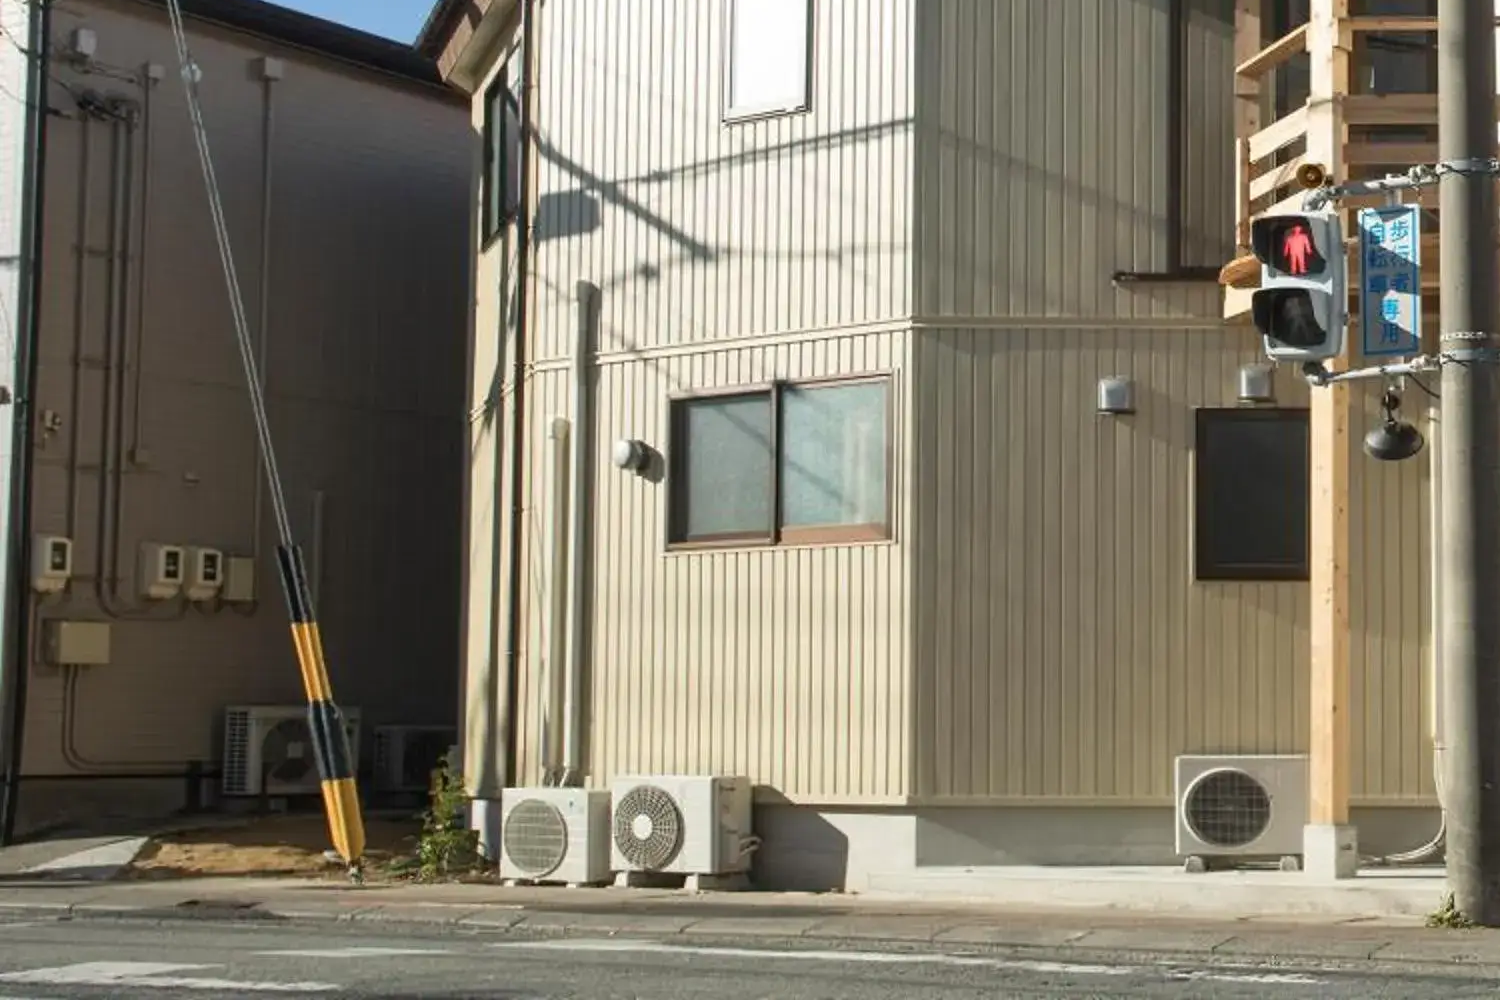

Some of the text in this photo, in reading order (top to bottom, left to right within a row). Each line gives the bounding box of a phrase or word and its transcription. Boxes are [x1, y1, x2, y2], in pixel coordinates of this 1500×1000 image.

[1369, 222, 1387, 293] 自転車
[1390, 219, 1410, 291] 歩行者
[1379, 297, 1400, 345] 専用
